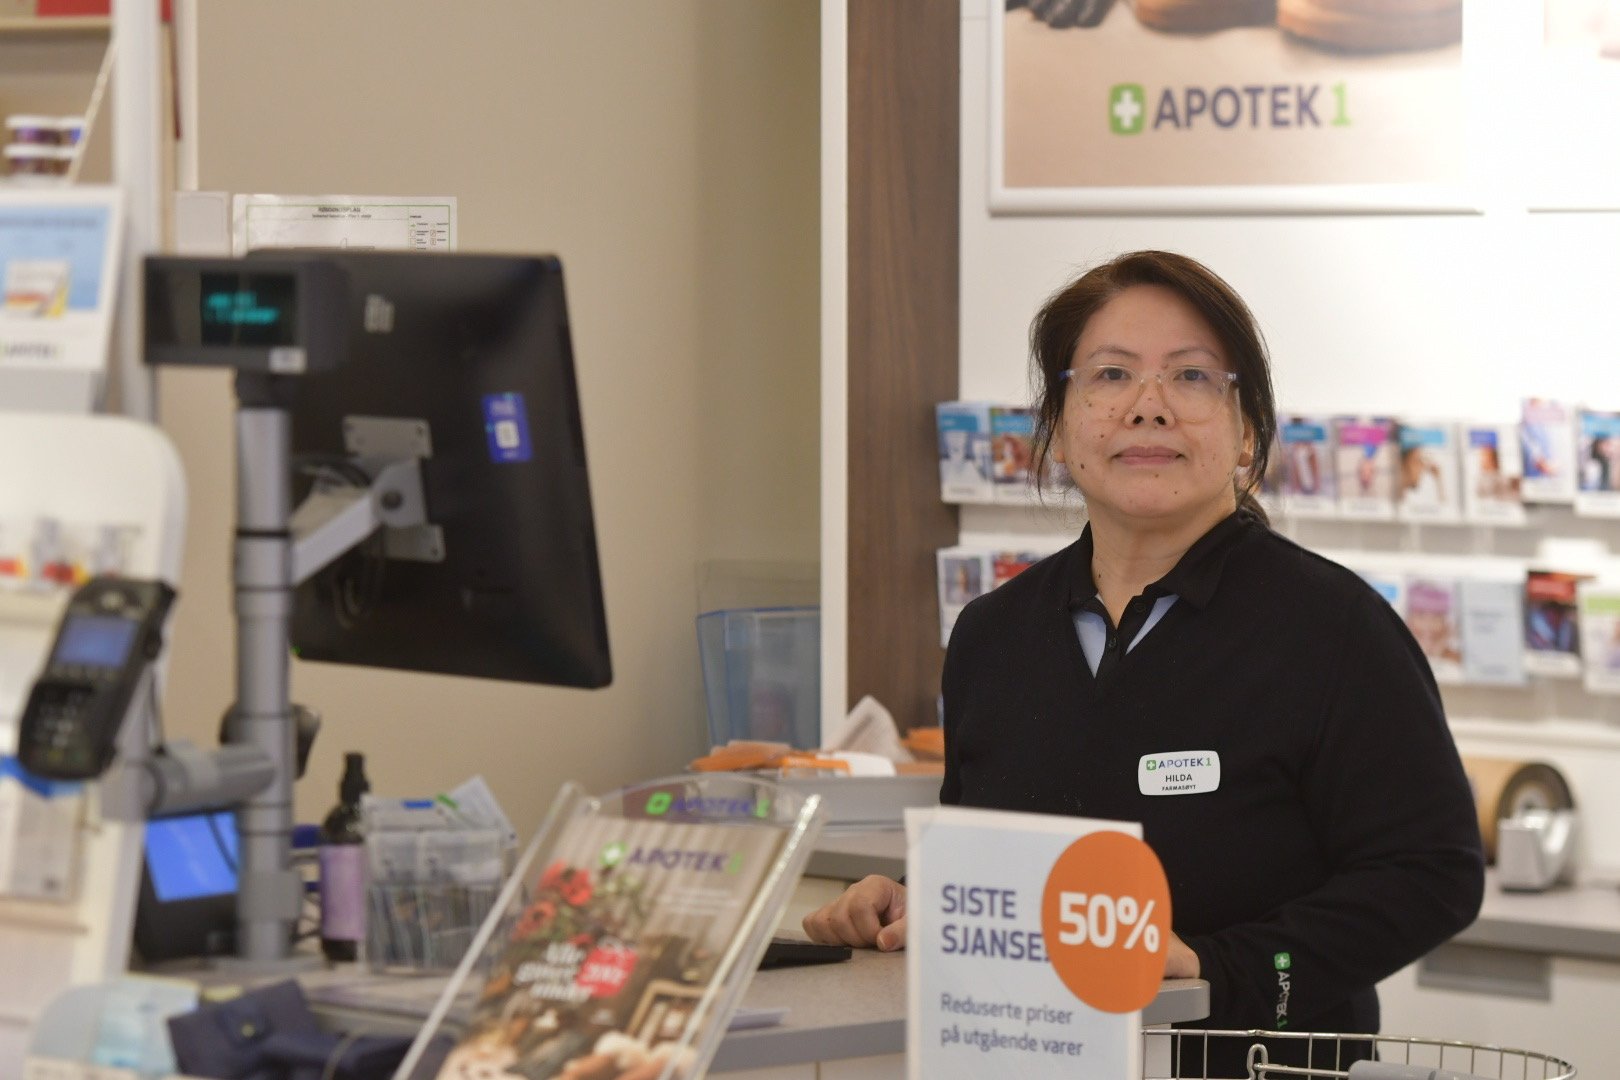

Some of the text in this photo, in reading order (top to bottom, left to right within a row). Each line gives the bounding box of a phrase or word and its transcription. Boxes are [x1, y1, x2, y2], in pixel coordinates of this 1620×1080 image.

[1153, 82, 1351, 130] APOTEK 1
[1158, 757, 1212, 768] APOTEK 1
[1165, 774, 1193, 782] HILDA
[628, 846, 728, 872] APOTEK
[941, 884, 1017, 920] SISTE
[1058, 890, 1160, 954] 50%
[941, 924, 1051, 963] SJANSE
[940, 992, 1073, 1028] Reduserte priser
[940, 1025, 1084, 1057] på utgående varer
